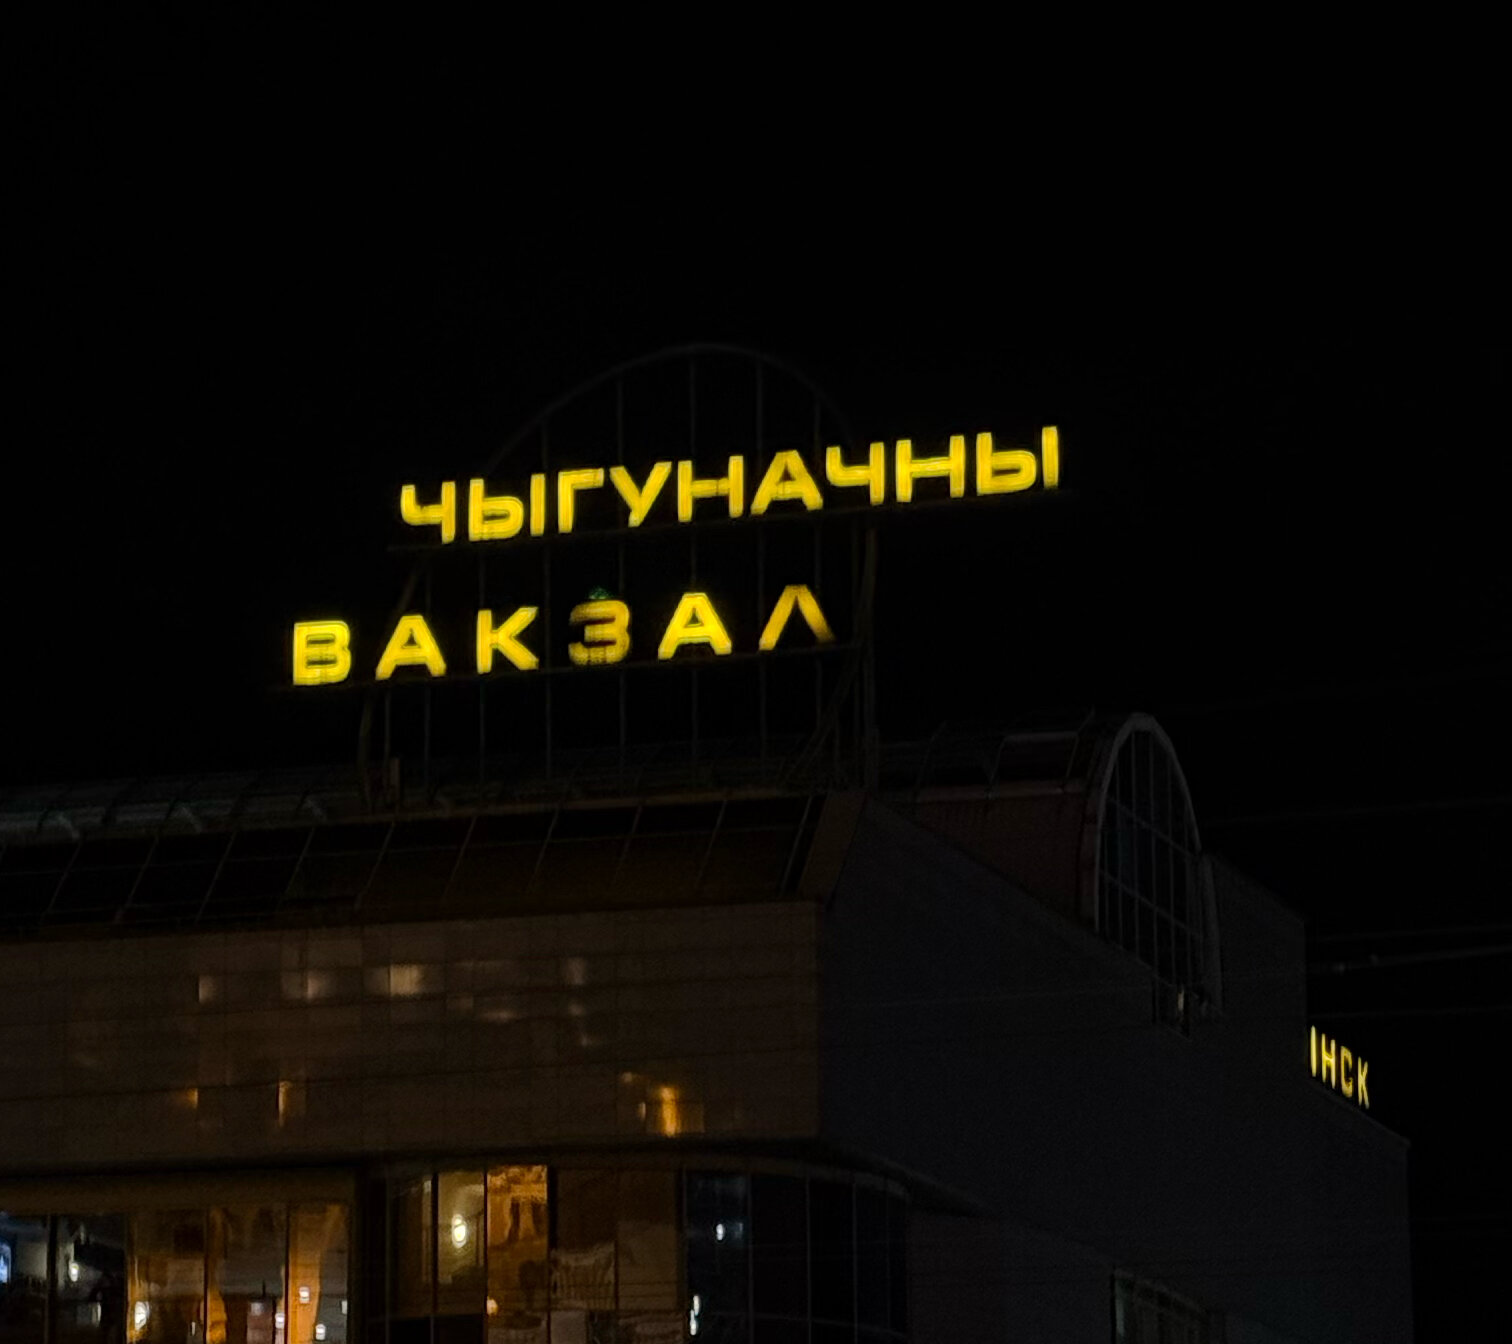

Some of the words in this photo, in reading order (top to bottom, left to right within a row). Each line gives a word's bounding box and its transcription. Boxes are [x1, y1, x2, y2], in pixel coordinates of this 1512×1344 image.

[399, 425, 1060, 545] ЧЫГУНАЧНЫ
[291, 584, 833, 687] ВАКЗАЛ
[1308, 1024, 1370, 1109] ІНСК
